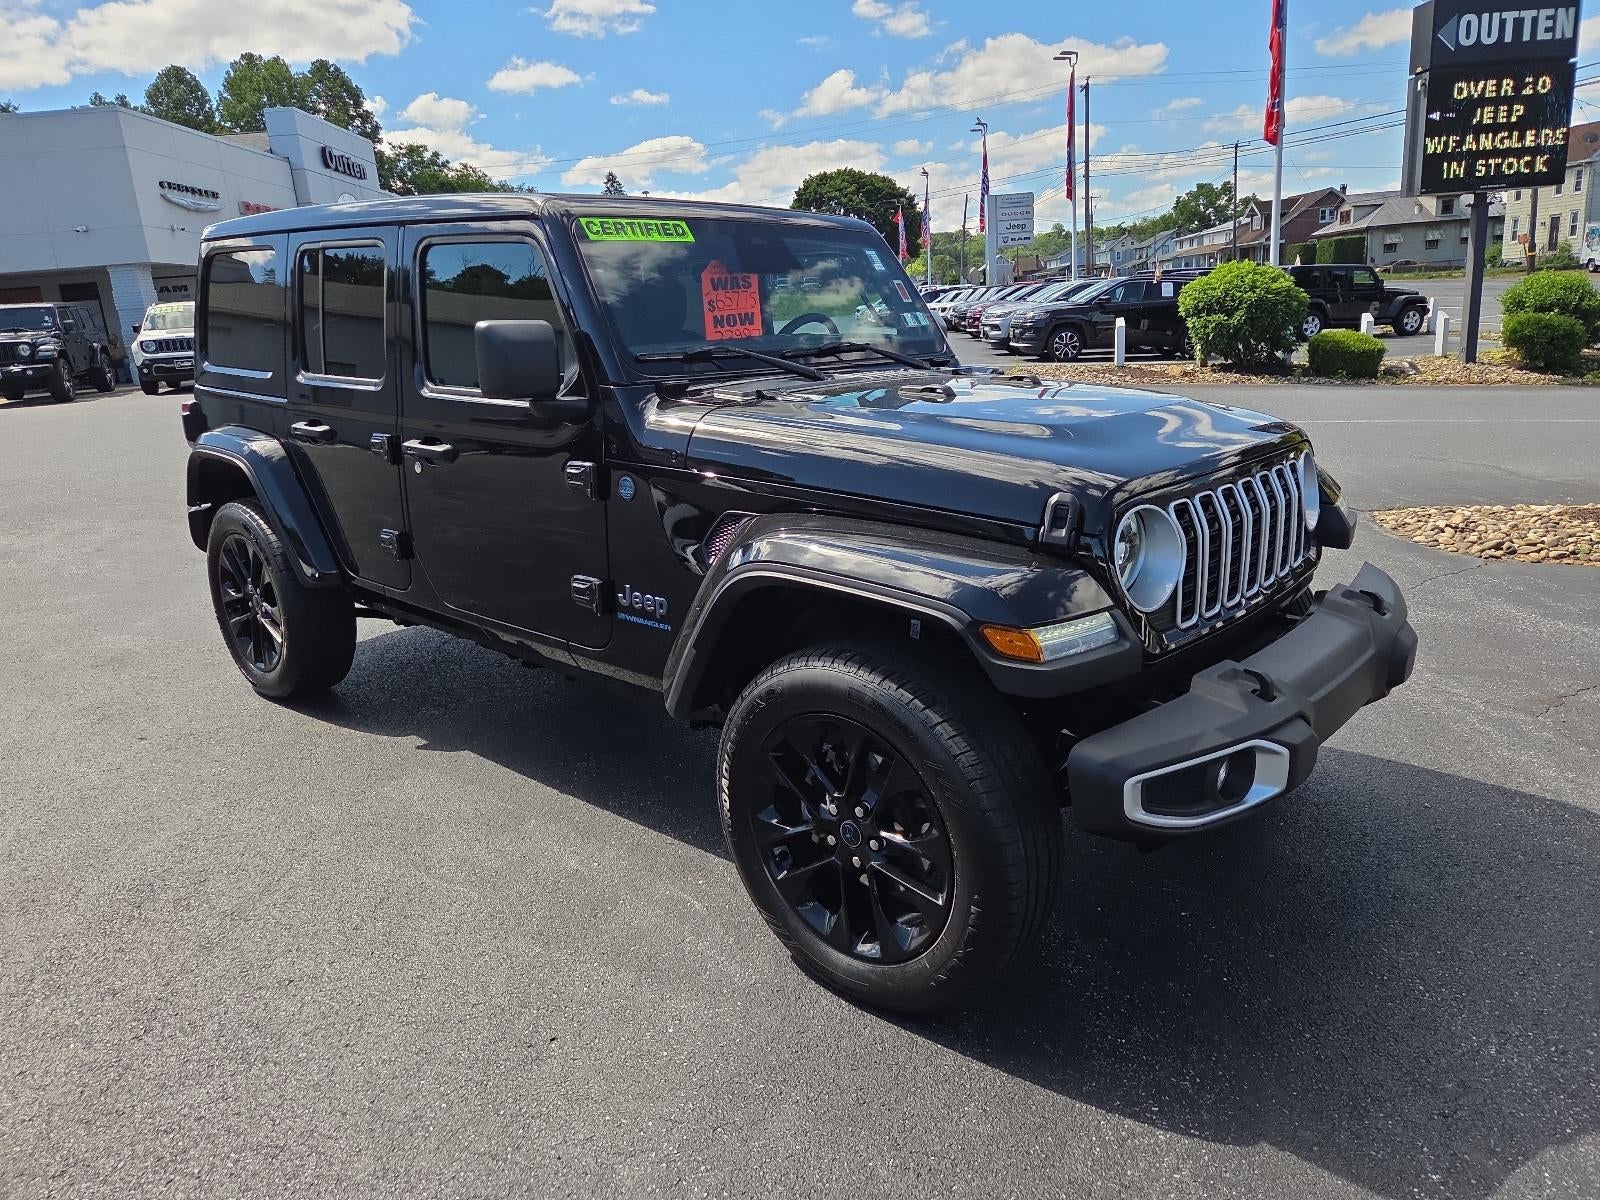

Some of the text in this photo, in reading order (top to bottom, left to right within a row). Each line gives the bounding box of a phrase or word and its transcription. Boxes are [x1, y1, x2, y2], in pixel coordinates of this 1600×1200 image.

[1458, 7, 1576, 46] OUTTEN
[1454, 75, 1552, 100] OVER 20
[1472, 104, 1524, 125] JEEP
[321, 145, 368, 180] Outten
[1443, 155, 1550, 178] IN STOCK
[585, 220, 688, 237] CERTIFIED
[1005, 222, 1027, 231] Jeep
[158, 284, 188, 294] AM
[711, 275, 752, 291] WAS
[712, 311, 756, 328] NOW
[617, 584, 668, 619] Jeep
